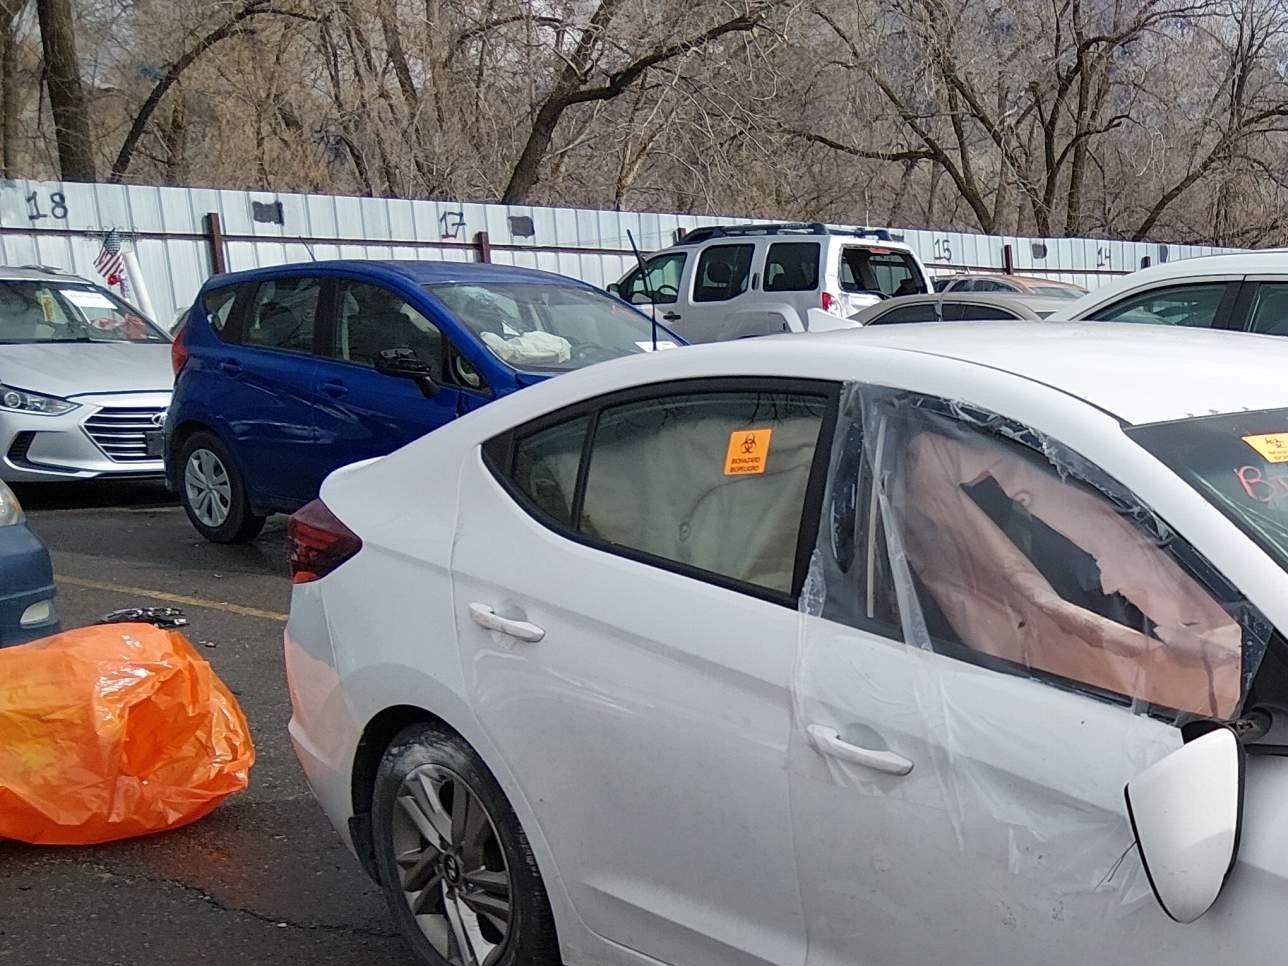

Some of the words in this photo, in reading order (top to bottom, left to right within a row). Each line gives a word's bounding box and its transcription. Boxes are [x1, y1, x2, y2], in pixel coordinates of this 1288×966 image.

[26, 190, 69, 220] 18
[440, 211, 467, 239] 17
[934, 238, 952, 262] 15
[1097, 246, 1112, 268] 14
